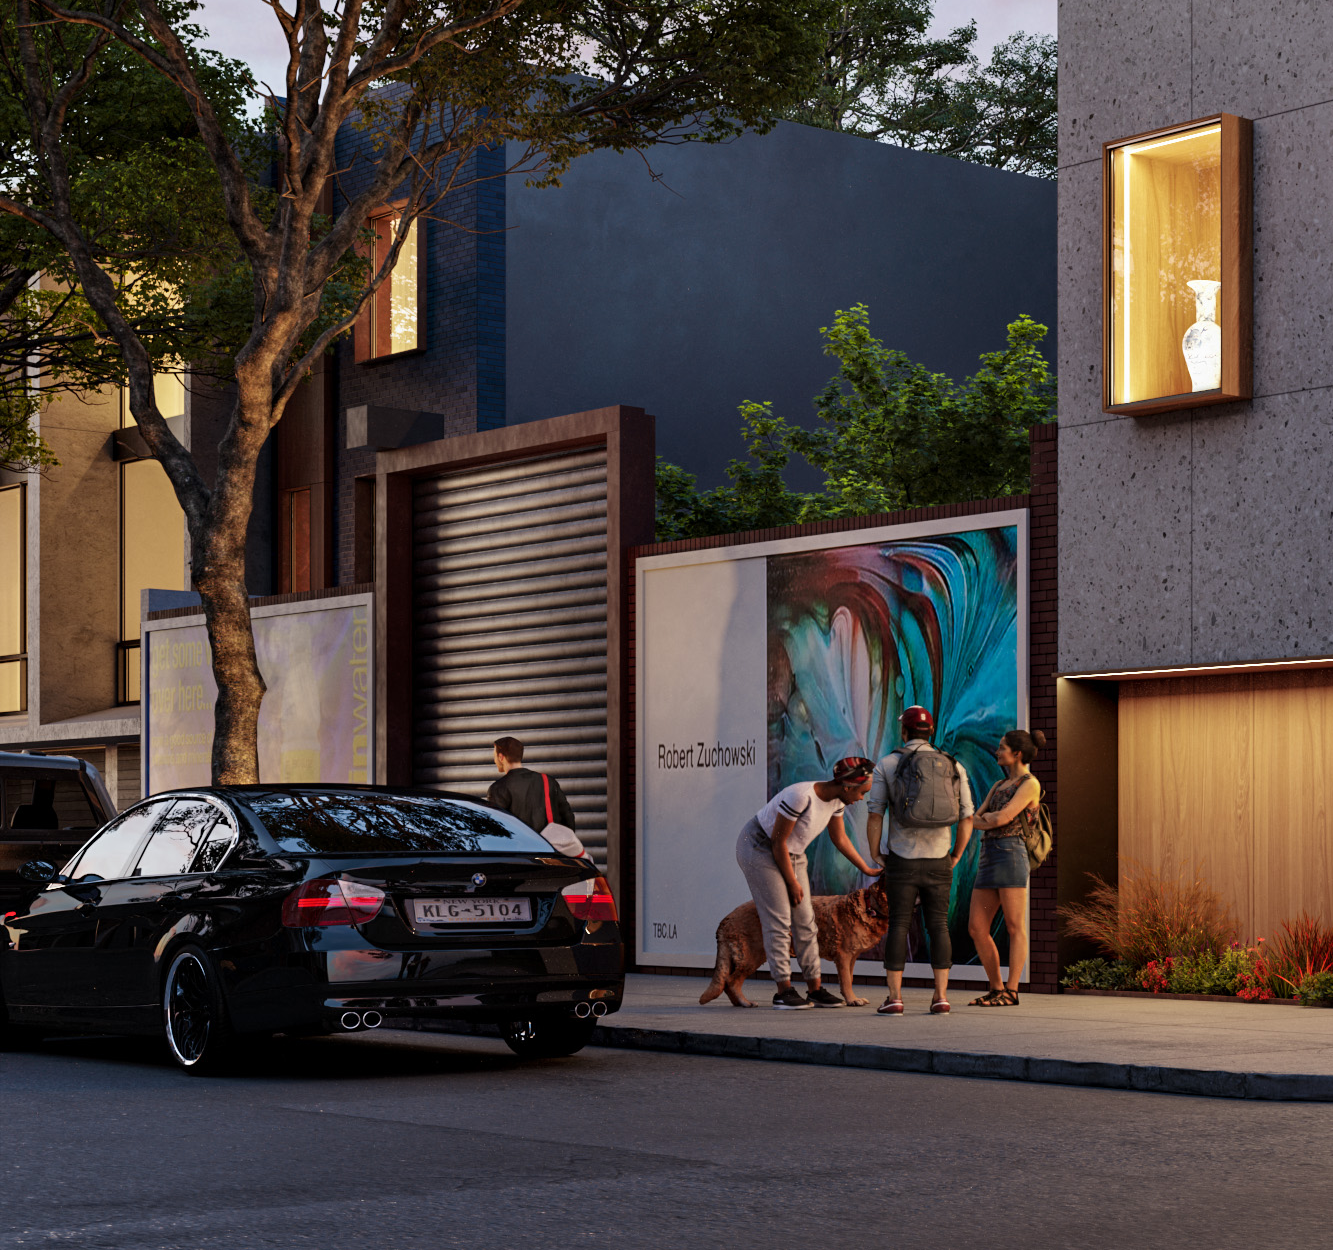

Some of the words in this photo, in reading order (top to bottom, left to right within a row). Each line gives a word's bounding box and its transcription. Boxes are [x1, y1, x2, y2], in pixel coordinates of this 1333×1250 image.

[152, 638, 170, 678] get
[172, 640, 203, 670] some
[152, 686, 177, 716] over
[658, 743, 694, 769] Robert
[697, 739, 756, 767] Zuchowski
